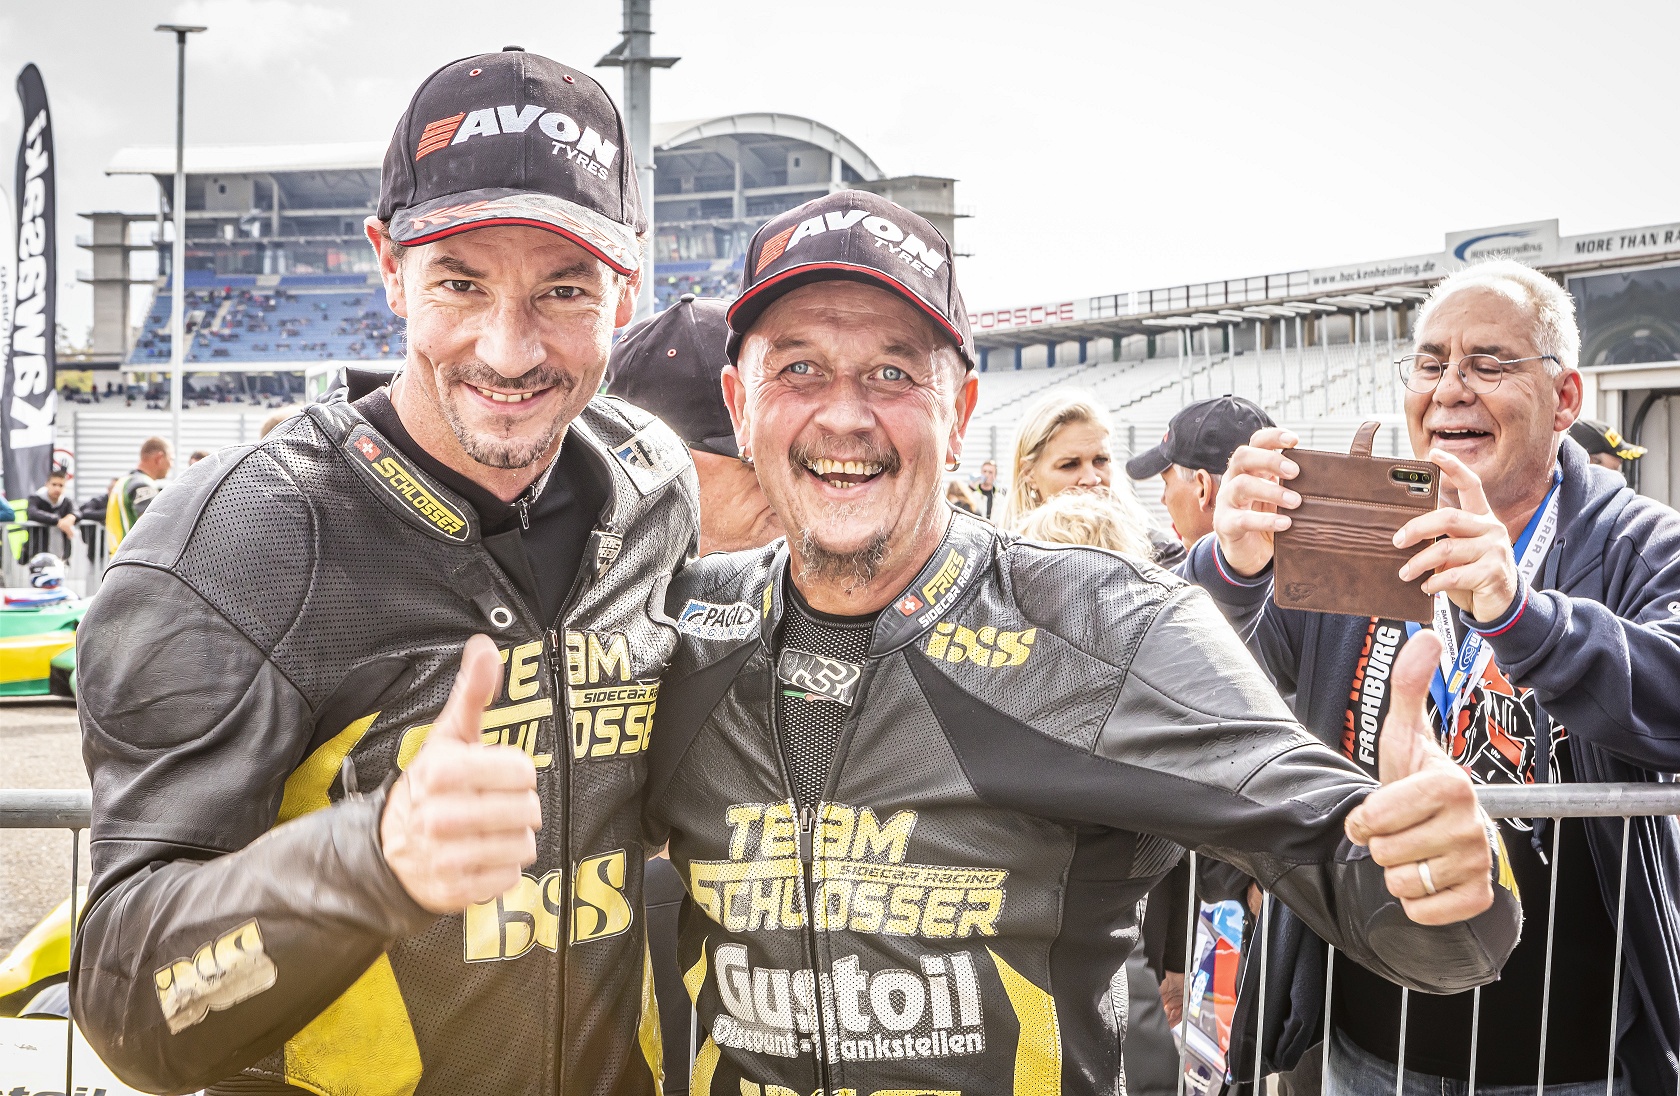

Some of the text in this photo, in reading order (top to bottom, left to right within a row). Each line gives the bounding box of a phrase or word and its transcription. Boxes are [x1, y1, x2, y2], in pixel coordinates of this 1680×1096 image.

[451, 104, 620, 169] AVON
[551, 140, 609, 181] TYRES
[784, 209, 946, 271] AVON
[873, 236, 935, 279] TYRES
[1574, 237, 1614, 255] MORE
[1619, 231, 1659, 250] THAN
[967, 302, 1073, 328] PORSCHE
[371, 456, 466, 535] SCHLOSSER
[917, 546, 978, 629] SIDECAR RACING
[921, 547, 965, 606] FRIES
[702, 605, 756, 628] PAGID
[1440, 609, 1449, 626] BMW
[582, 688, 647, 704] SIDECAR
[1358, 625, 1402, 766] FROHBURG
[726, 798, 919, 864] TEAM
[689, 859, 1008, 939] SCHLOSSER
[838, 864, 1001, 885] SIDECAR RACING
